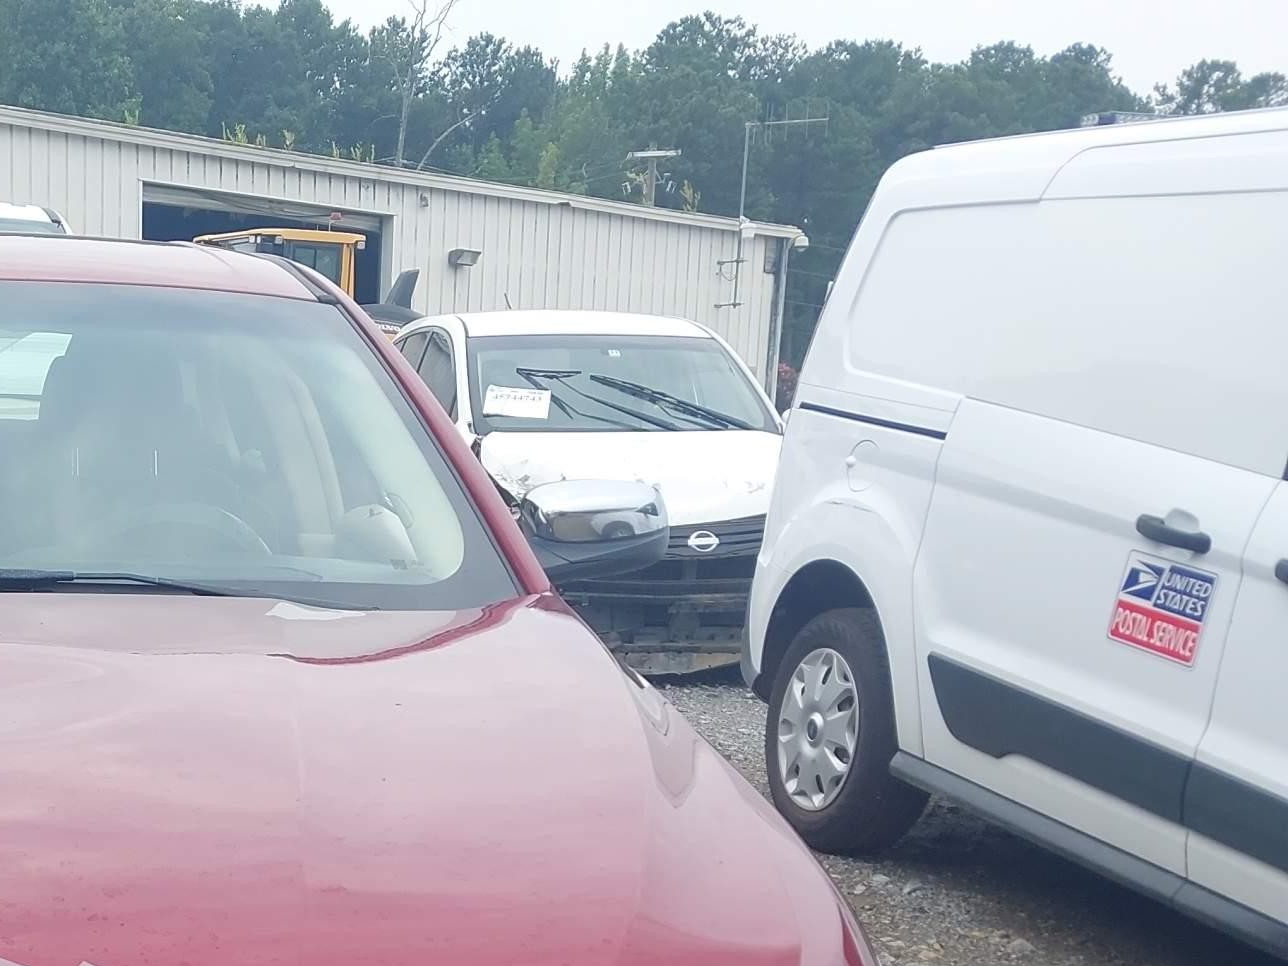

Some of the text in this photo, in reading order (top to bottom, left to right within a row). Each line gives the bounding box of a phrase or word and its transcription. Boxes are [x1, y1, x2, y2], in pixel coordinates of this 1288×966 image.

[1164, 571, 1212, 598] UNITED
[1157, 589, 1205, 616] STATES
[1112, 607, 1198, 657] POSTAL SERVICE
